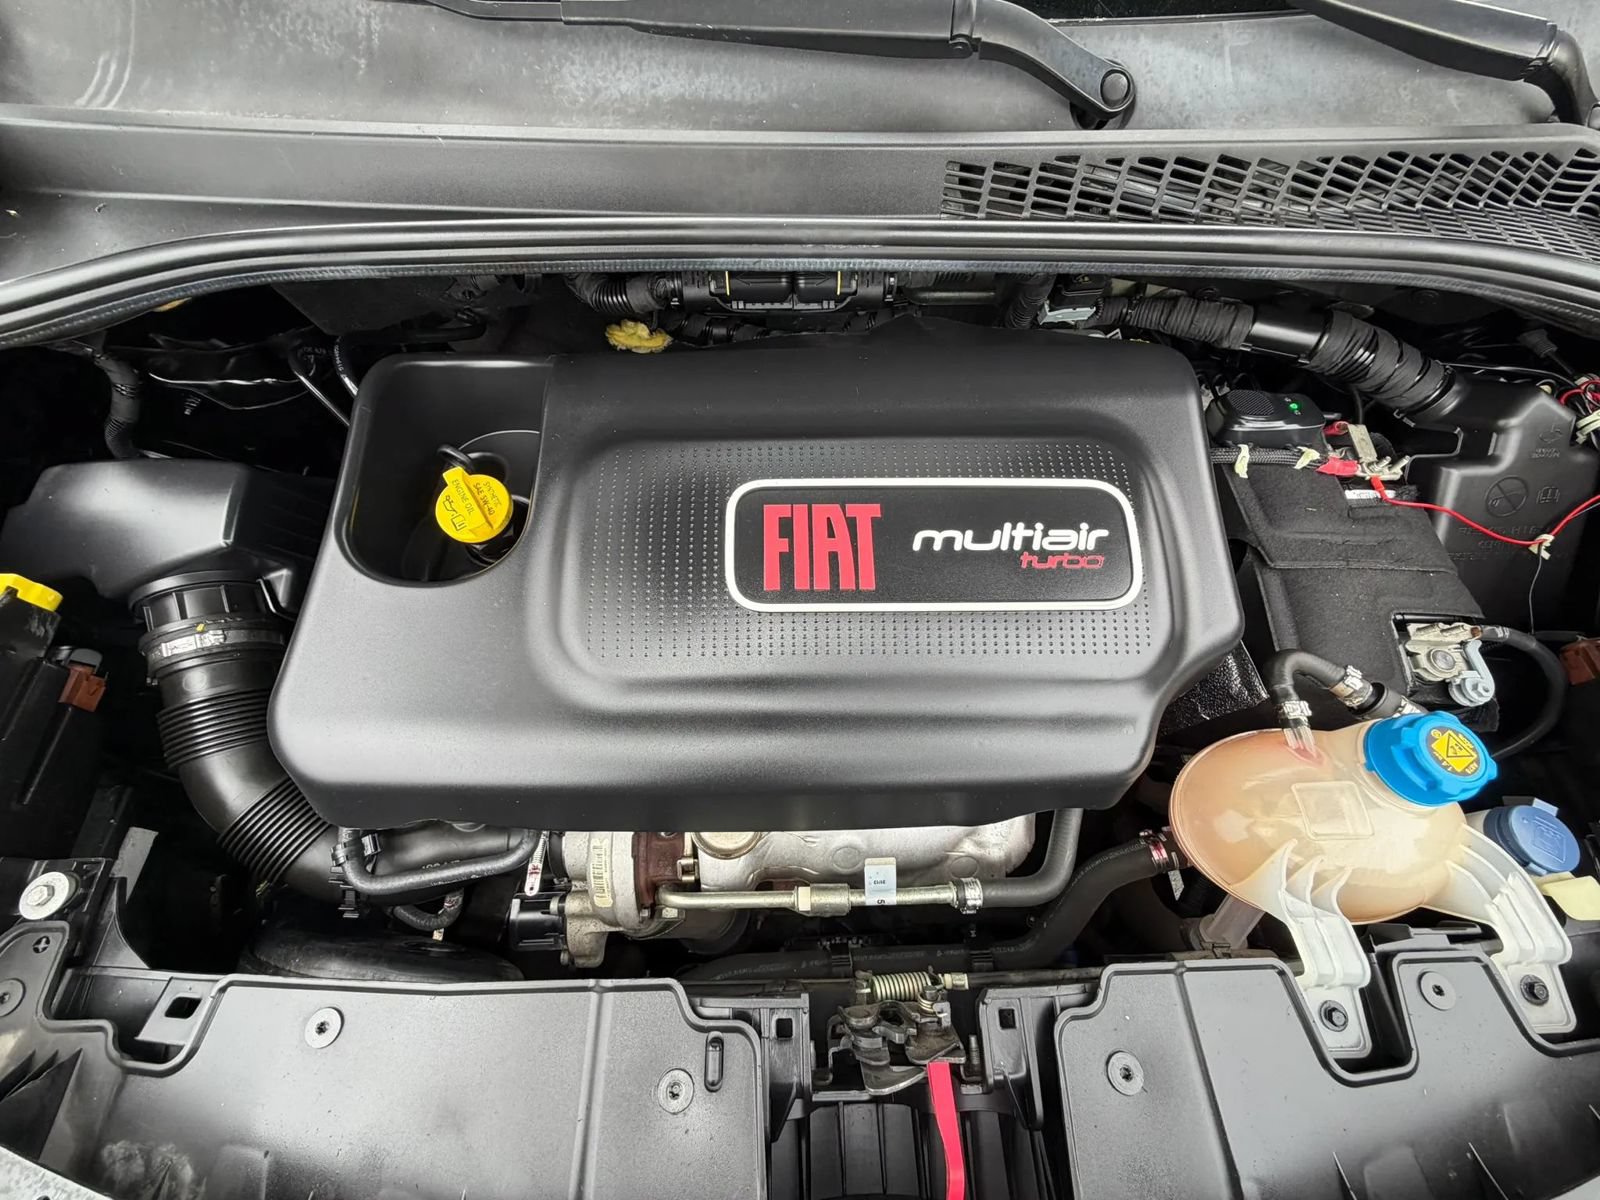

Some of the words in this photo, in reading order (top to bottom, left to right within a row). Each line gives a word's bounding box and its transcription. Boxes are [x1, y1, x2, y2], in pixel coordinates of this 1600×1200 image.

[451, 479, 469, 504] ENGINE
[465, 501, 476, 516] OIL
[473, 482, 484, 499] SAE
[479, 496, 496, 515] 5W-40
[763, 503, 881, 591] FIAT
[912, 522, 1109, 551] multiair
[1019, 552, 1105, 570] turbo
